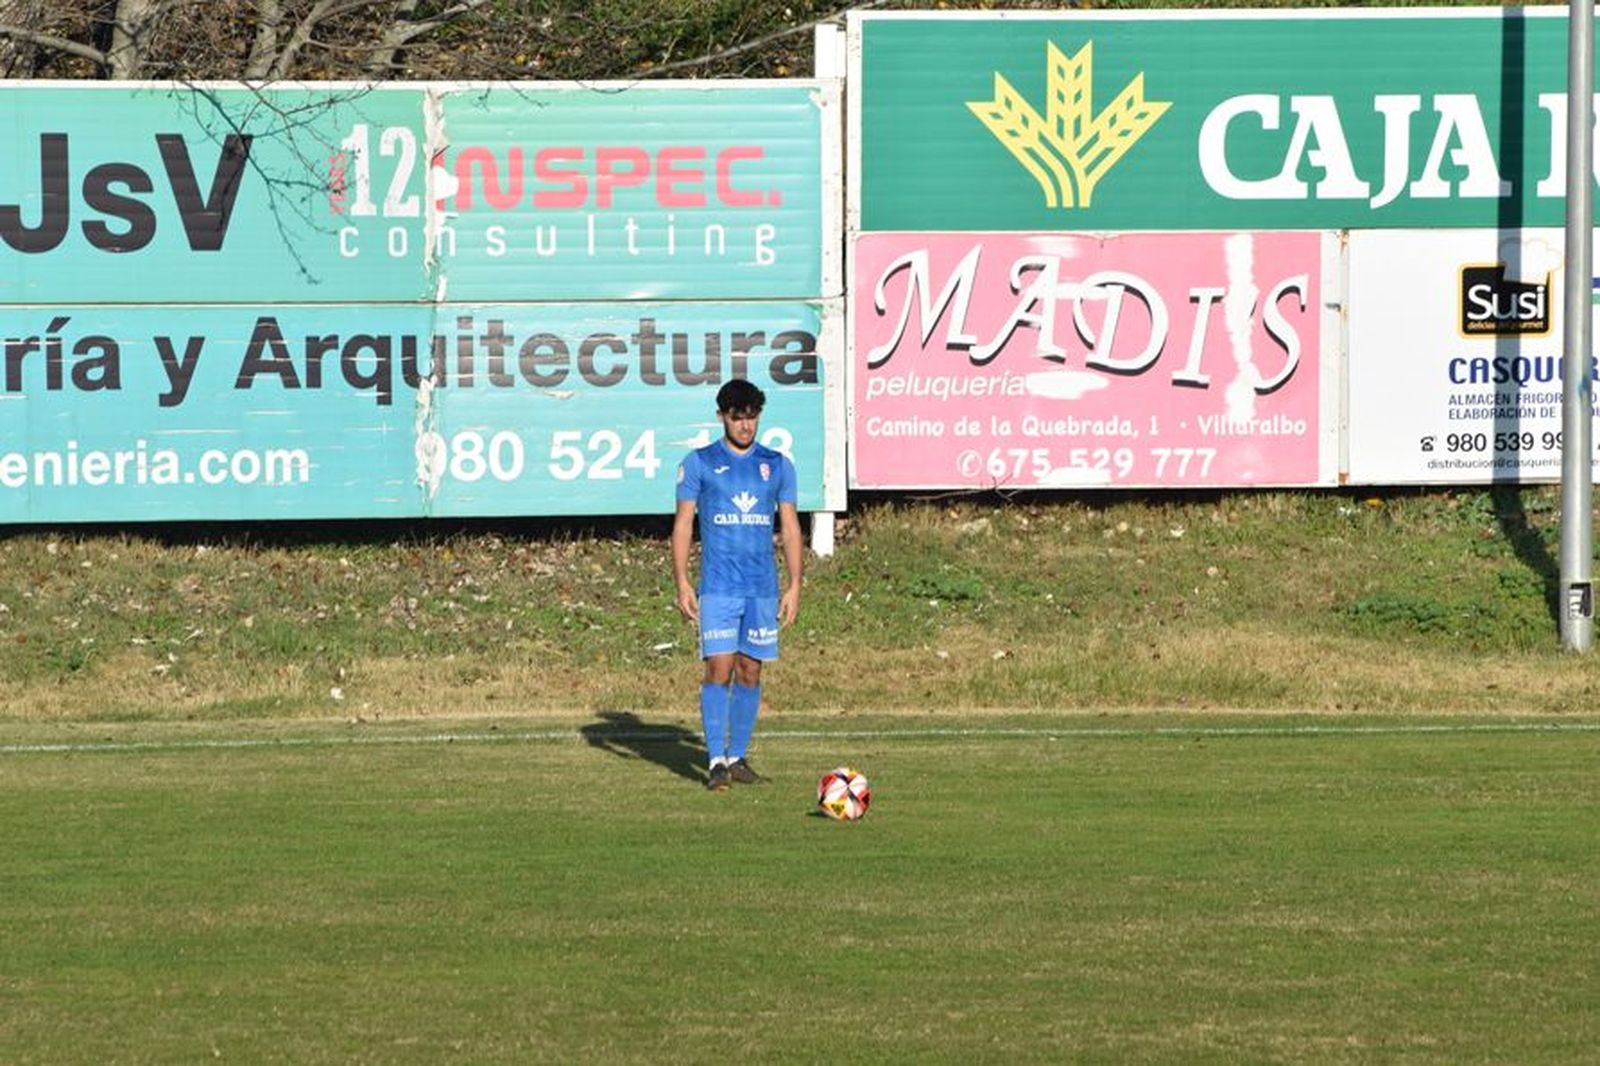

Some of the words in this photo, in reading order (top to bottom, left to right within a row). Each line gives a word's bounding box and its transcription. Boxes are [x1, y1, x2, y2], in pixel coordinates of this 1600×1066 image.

[1198, 94, 1513, 208] CAJA
[0, 132, 254, 254] JsV
[340, 214, 776, 266] consulting
[1467, 283, 1545, 320] Susi
[153, 336, 205, 407] y
[235, 316, 819, 405] Arquitectura
[866, 371, 1027, 401] peluquería
[866, 416, 944, 437] Camino
[954, 417, 980, 436] de
[991, 416, 1012, 436] la
[1021, 416, 1139, 437] Quebrada,
[1149, 417, 1159, 436] 1
[1540, 406, 1556, 418] DE
[547, 430, 661, 480] 524
[1447, 432, 1487, 452] 980
[1494, 432, 1534, 451] 539
[986, 448, 1051, 478] 675
[1069, 448, 1133, 478] 529
[1151, 448, 1216, 477] 777
